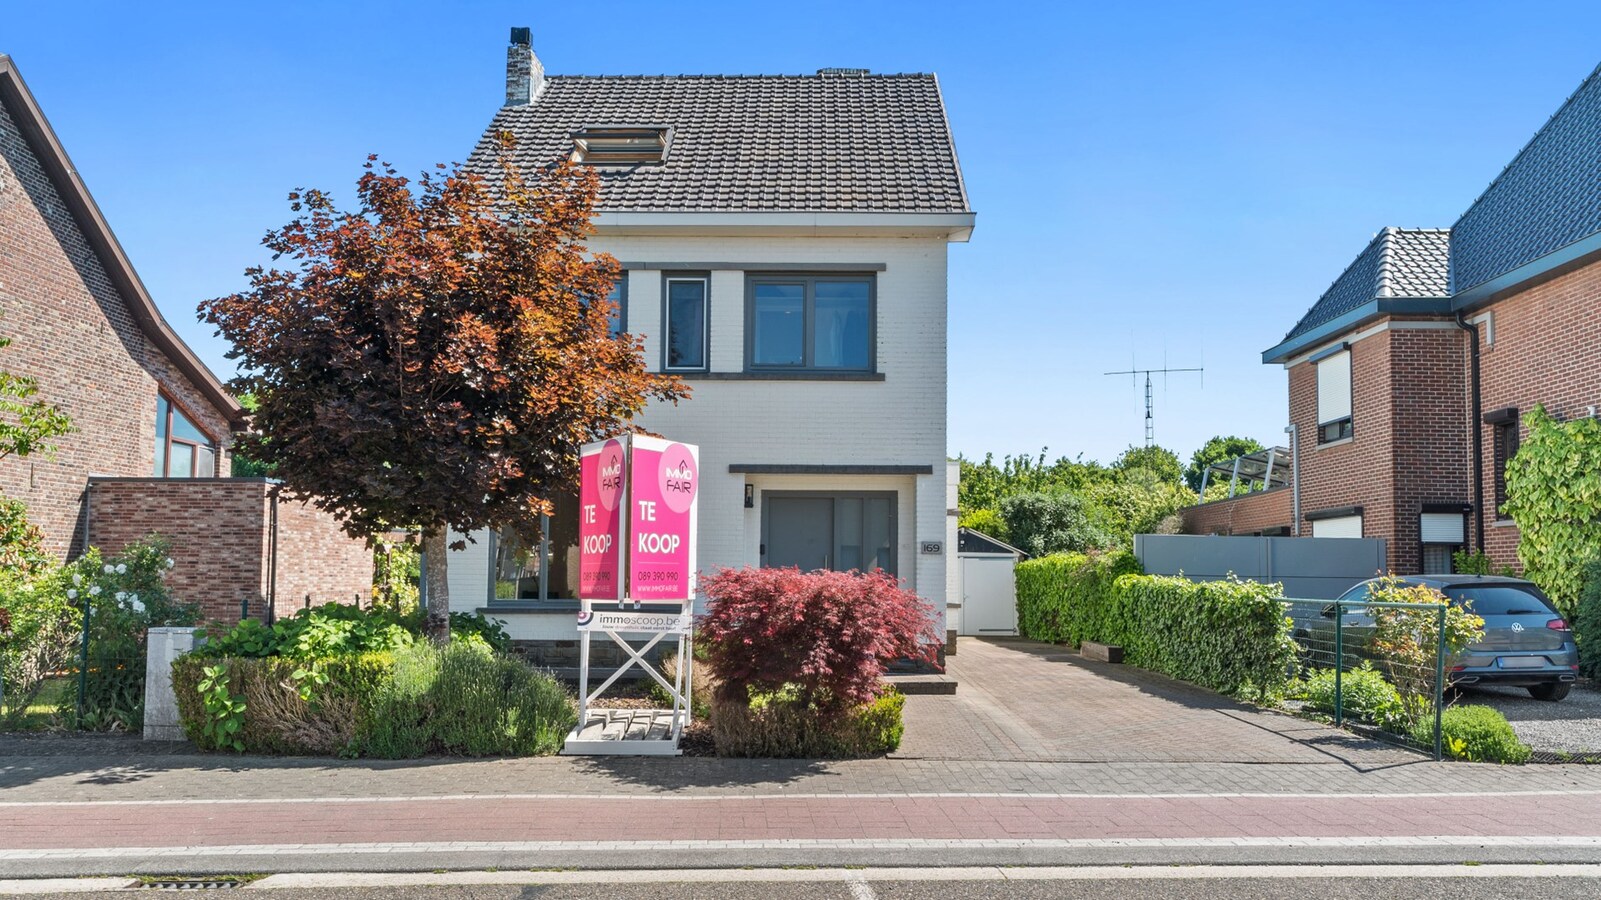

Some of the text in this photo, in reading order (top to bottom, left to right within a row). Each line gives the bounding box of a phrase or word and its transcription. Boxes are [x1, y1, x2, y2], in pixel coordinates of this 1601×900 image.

[602, 464, 620, 477] IMMO
[666, 467, 692, 479] IMMO
[602, 477, 620, 491] FAIR
[666, 480, 691, 493] FAIR
[584, 504, 596, 524] TE
[638, 500, 656, 521] TE
[584, 534, 612, 554] KOOP
[638, 532, 680, 554] KOOP
[923, 544, 940, 553] 169
[638, 571, 679, 581] 089 390 990
[599, 614, 680, 626] immoscoop.be
